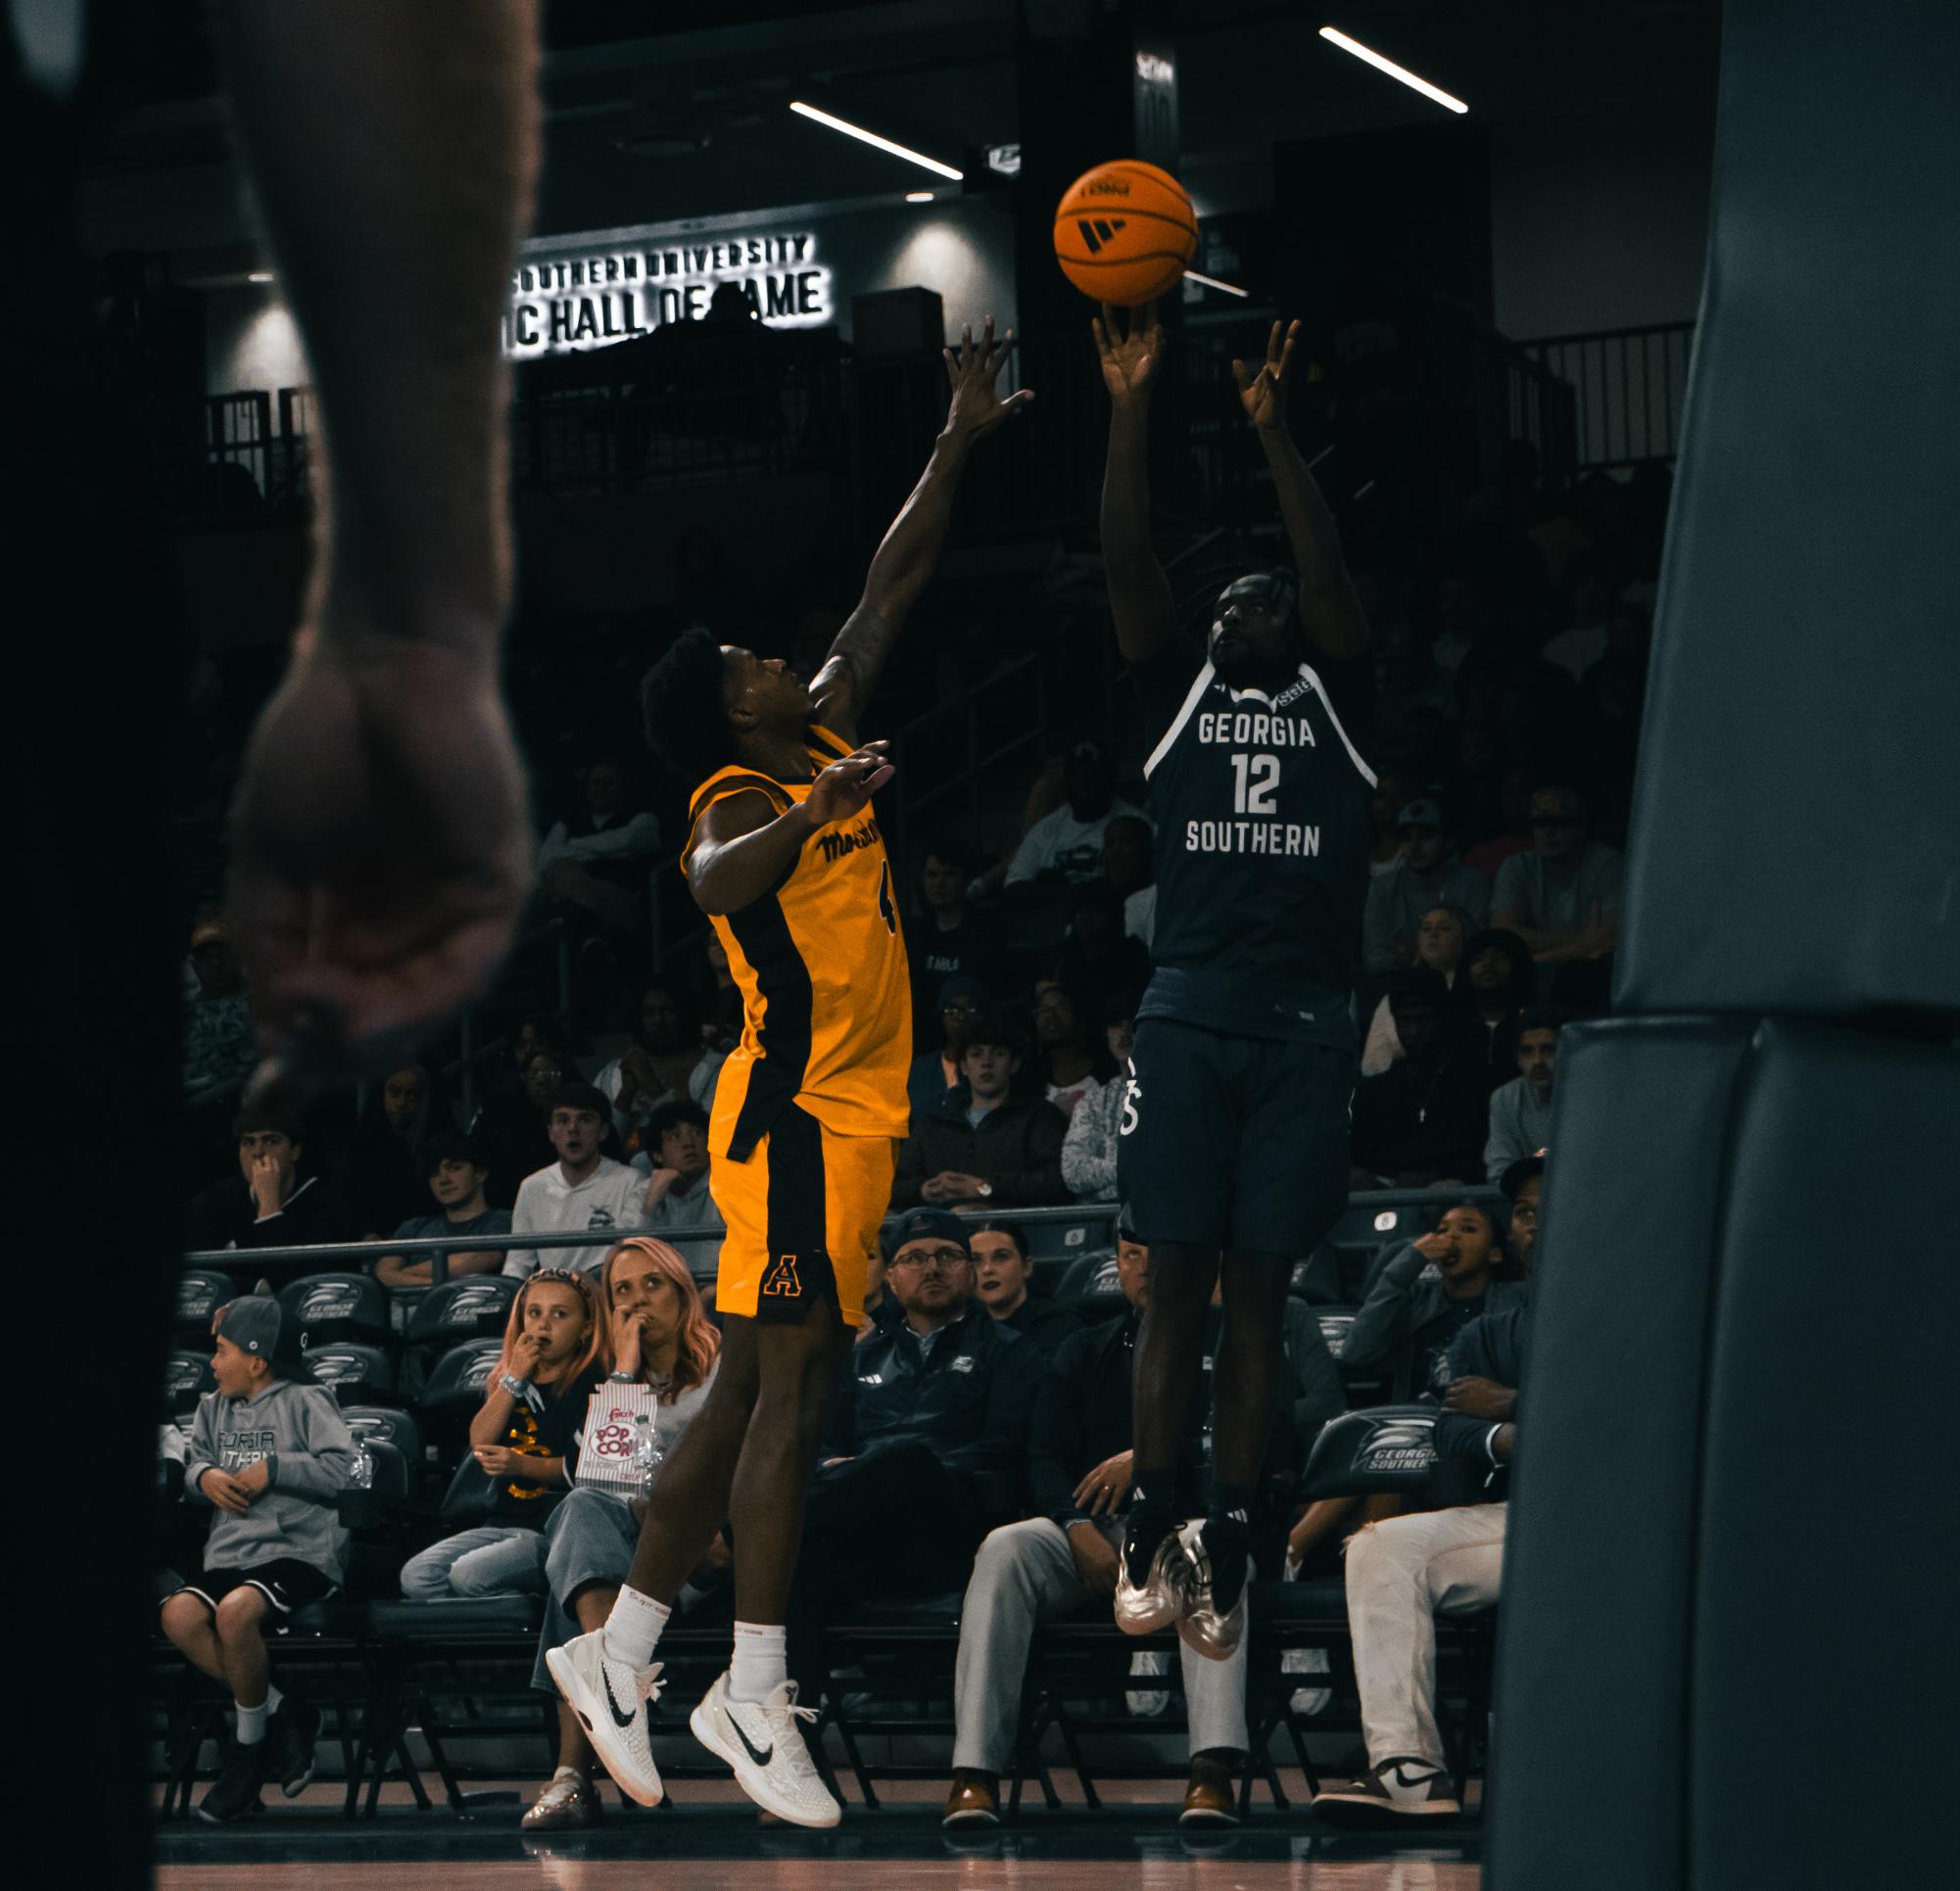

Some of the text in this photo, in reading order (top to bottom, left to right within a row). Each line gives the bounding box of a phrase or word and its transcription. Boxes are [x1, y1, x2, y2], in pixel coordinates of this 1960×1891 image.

[645, 234, 809, 276] UNIVERSITY
[550, 291, 646, 343] HALL
[1198, 713, 1316, 747] GEORGIA
[1230, 753, 1281, 815] 12
[1185, 820, 1320, 857] SOUTHERN
[763, 1254, 802, 1297] A
